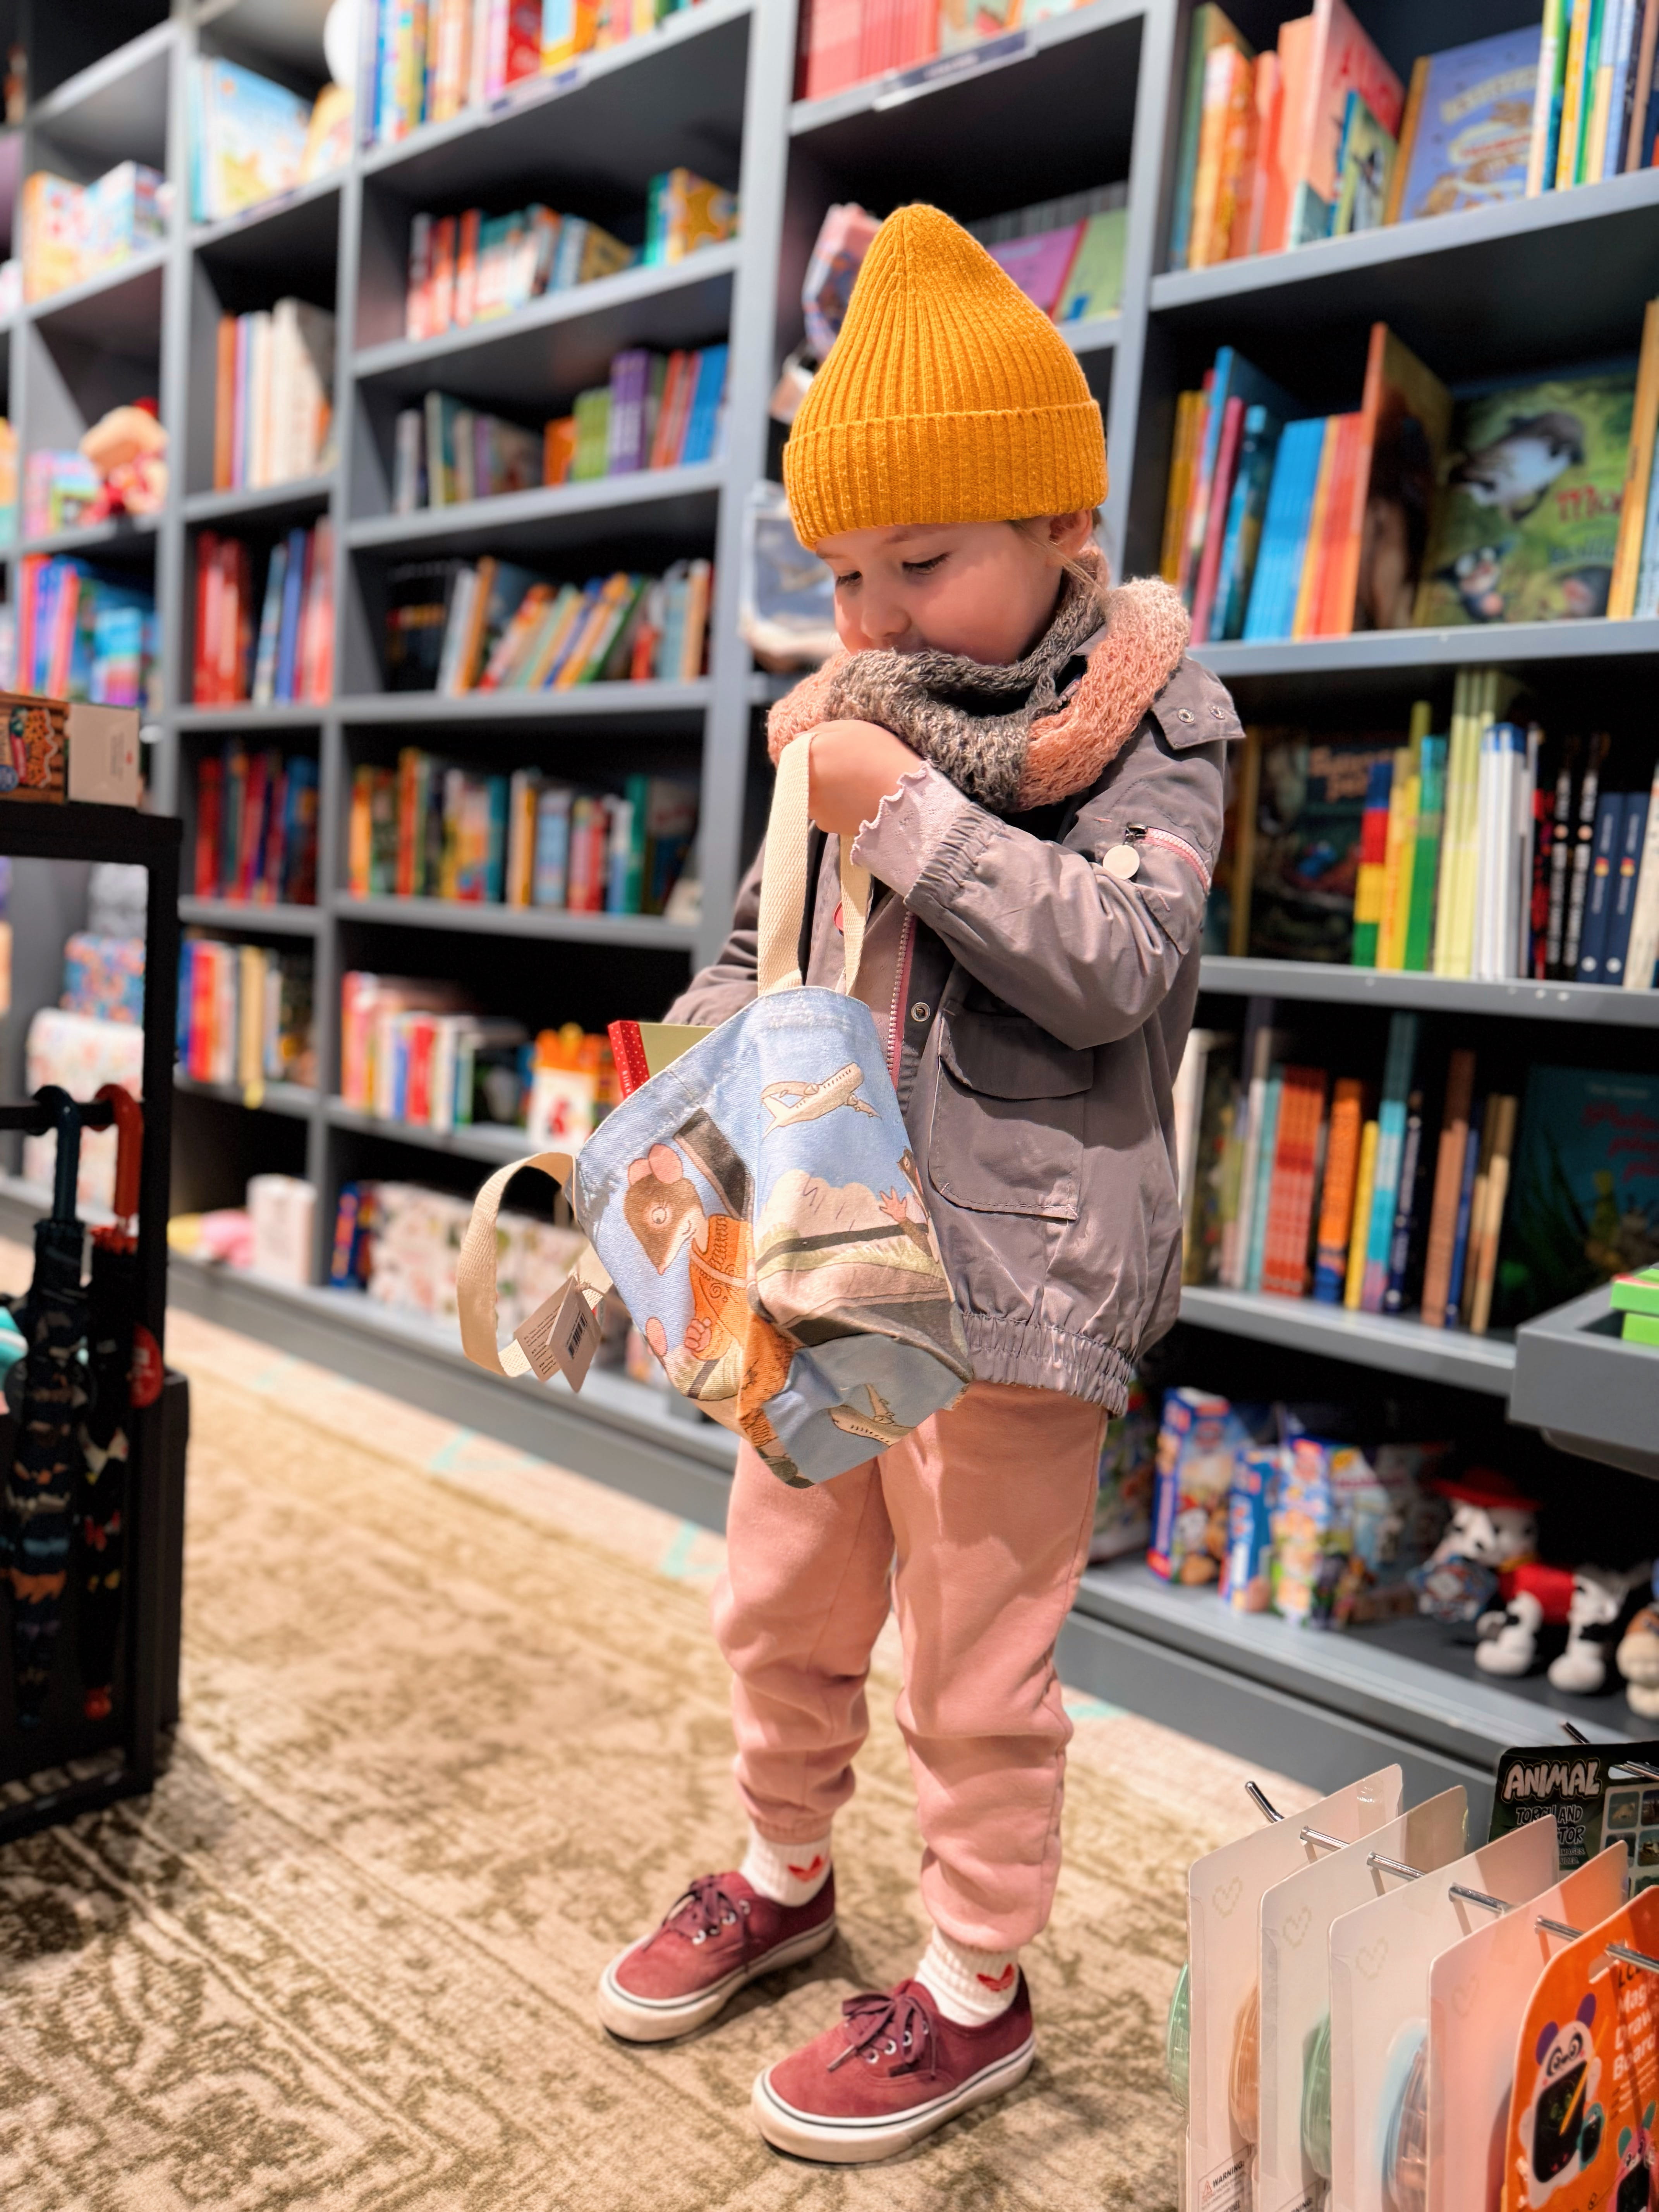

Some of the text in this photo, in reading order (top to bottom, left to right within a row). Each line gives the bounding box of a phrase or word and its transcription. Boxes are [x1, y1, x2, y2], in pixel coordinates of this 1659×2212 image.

[622, 1070, 632, 1094] RIIKK
[1503, 1760, 1601, 1801] ANIMAL
[1558, 1804, 1583, 1824] AND
[1613, 2025, 1657, 2081] Board
